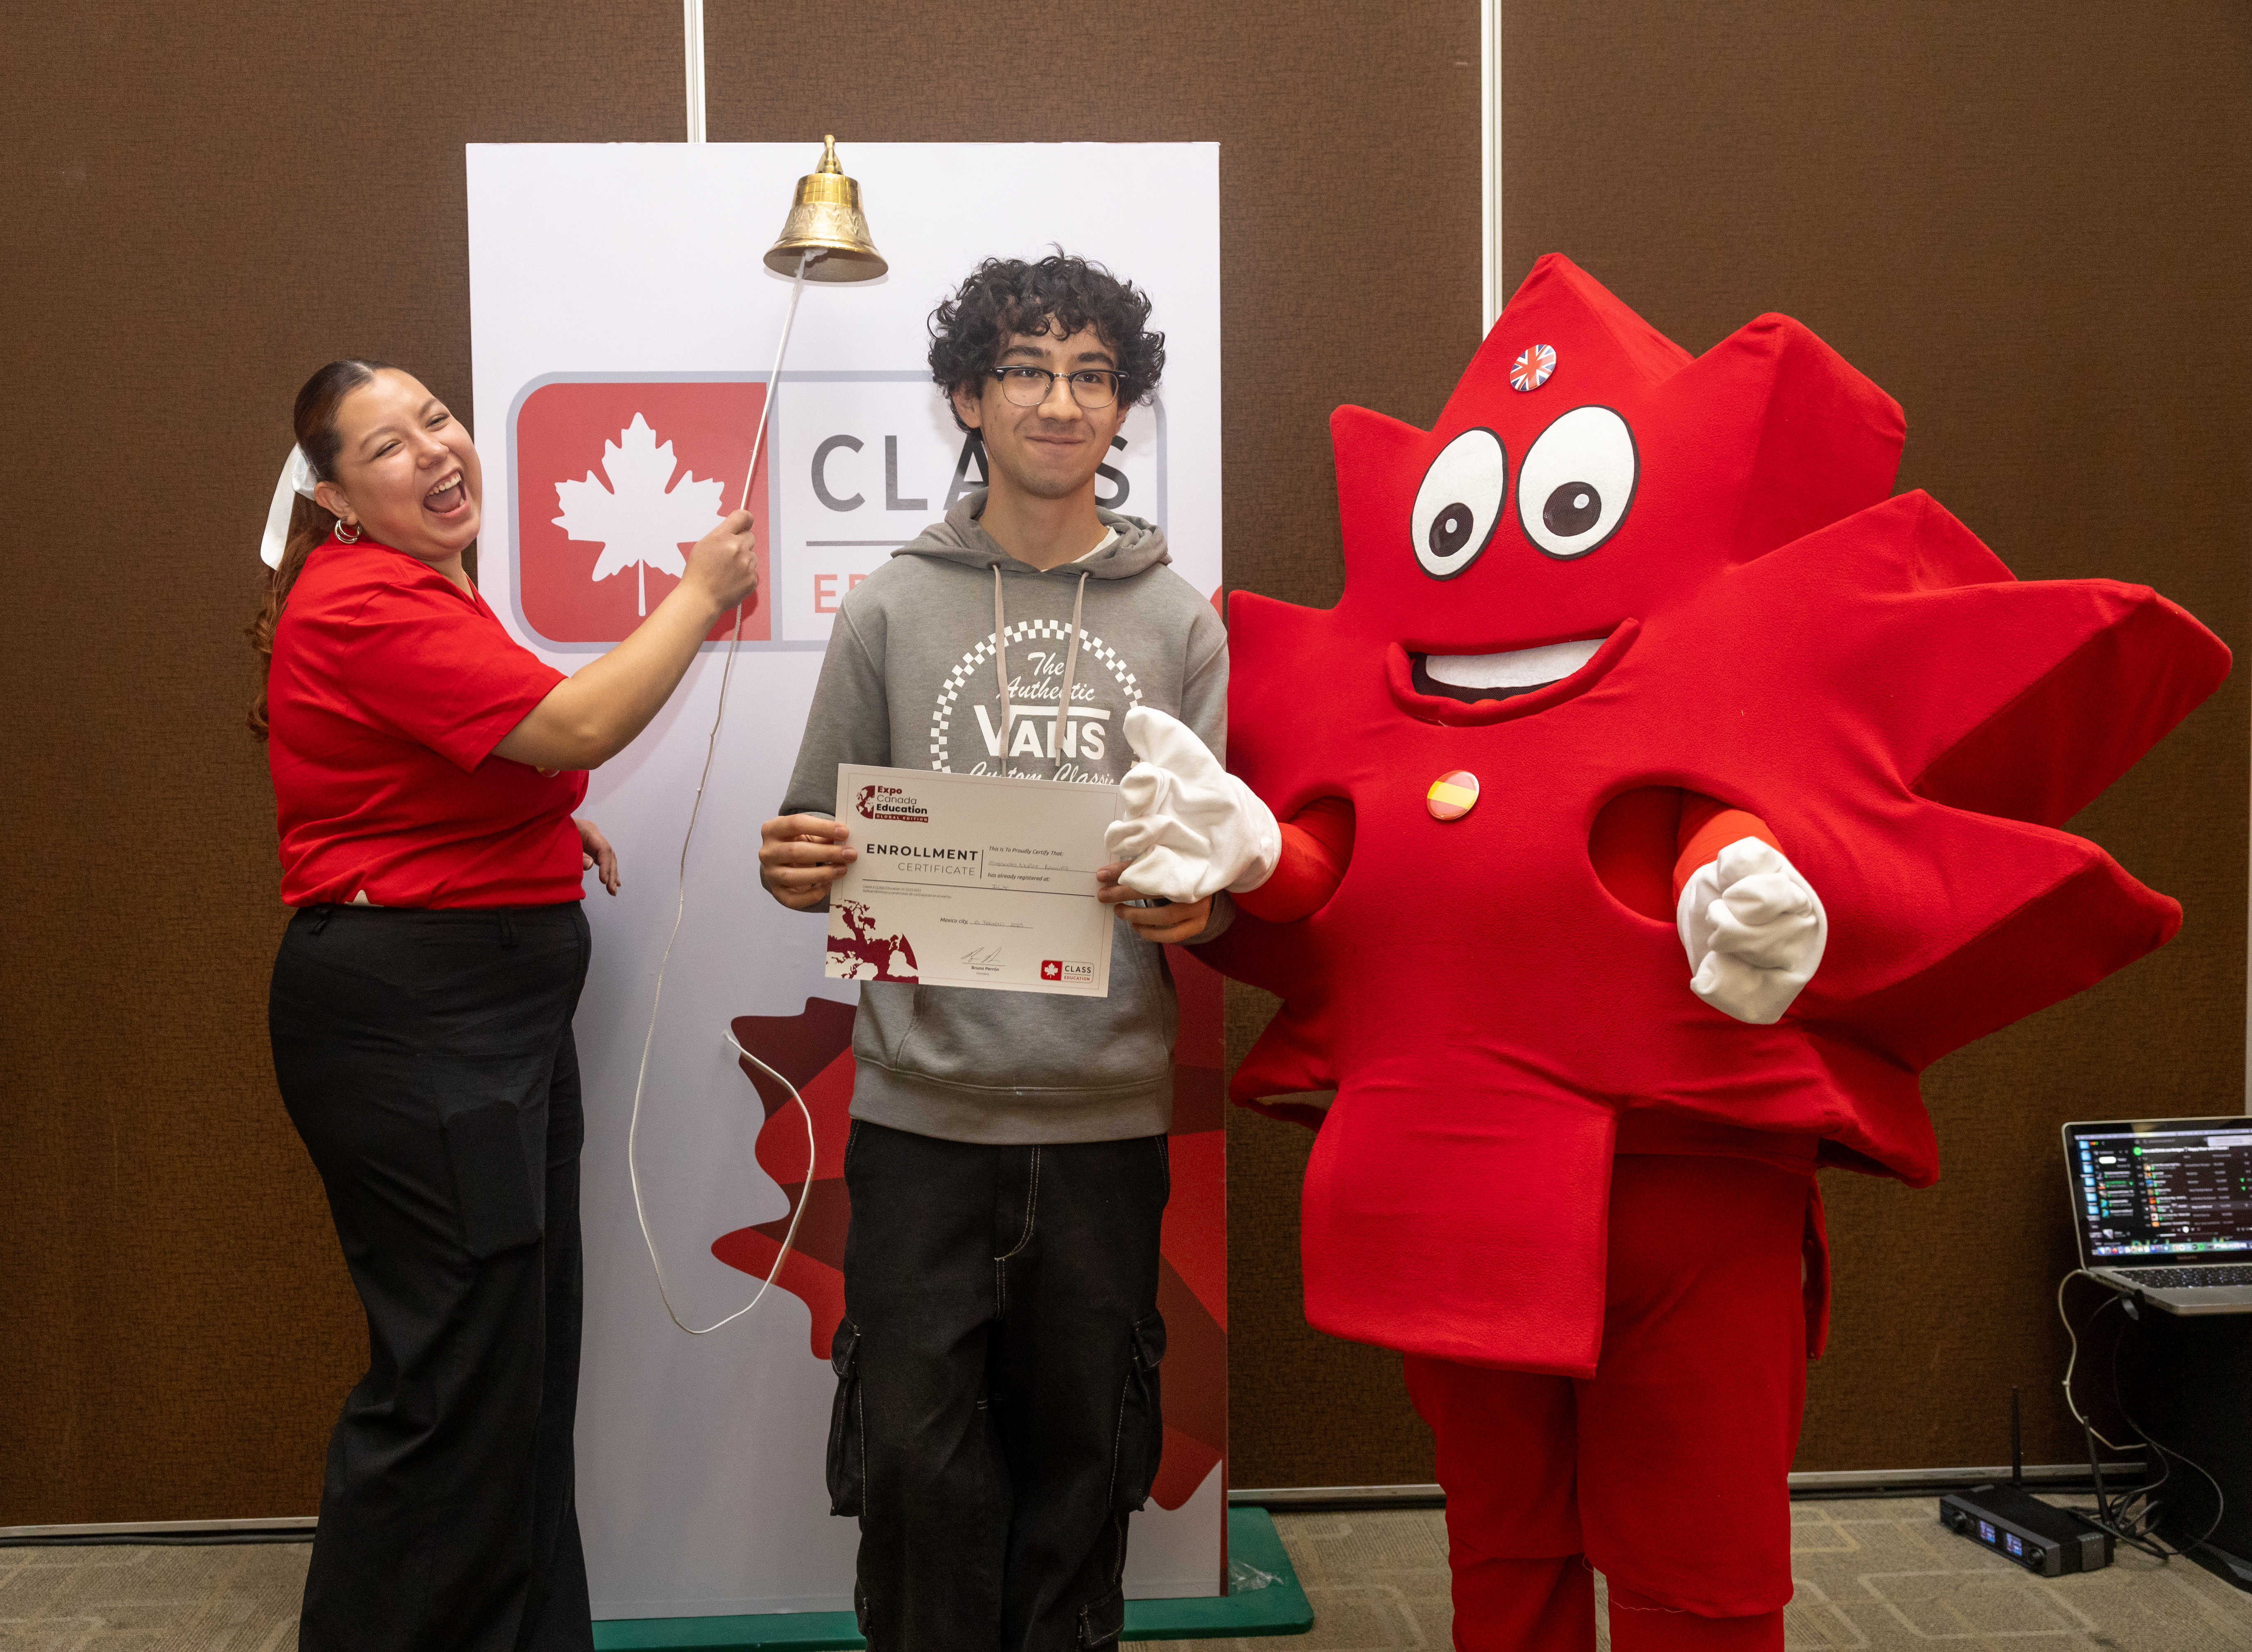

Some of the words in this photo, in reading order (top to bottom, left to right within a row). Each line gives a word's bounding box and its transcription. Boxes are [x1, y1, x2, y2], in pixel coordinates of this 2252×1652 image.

[811, 434, 1130, 512] CLAS
[1028, 652, 1064, 676] The
[996, 676, 1095, 701] Authetic
[973, 705, 1111, 760] VANS
[877, 794, 917, 804] Canada
[878, 786, 902, 796] Expo
[876, 803, 928, 814] Education
[866, 843, 978, 861] ENROLLMENT
[898, 862, 975, 875] CERTIFICATE
